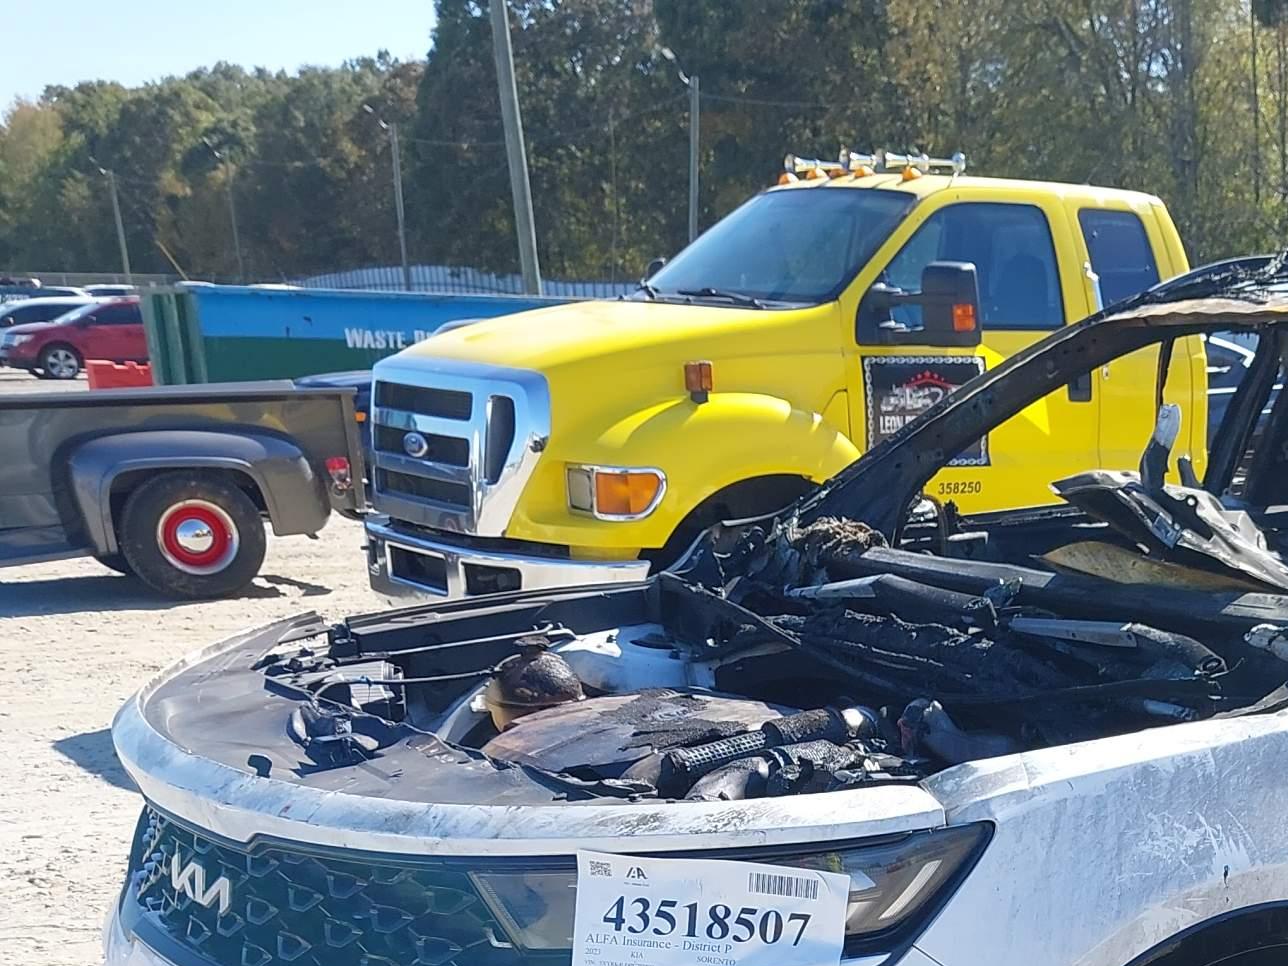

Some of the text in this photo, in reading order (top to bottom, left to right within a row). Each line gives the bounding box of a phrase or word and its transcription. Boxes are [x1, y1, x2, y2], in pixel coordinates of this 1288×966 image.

[344, 328, 407, 349] WASTE
[938, 481, 981, 495] 358250
[603, 895, 812, 947] 43518507
[585, 933, 619, 946] ALFA
[622, 935, 672, 949] Insurance
[683, 940, 722, 954] District
[724, 944, 733, 955] P
[630, 951, 644, 960] KIA
[696, 955, 737, 966] SORENTO
